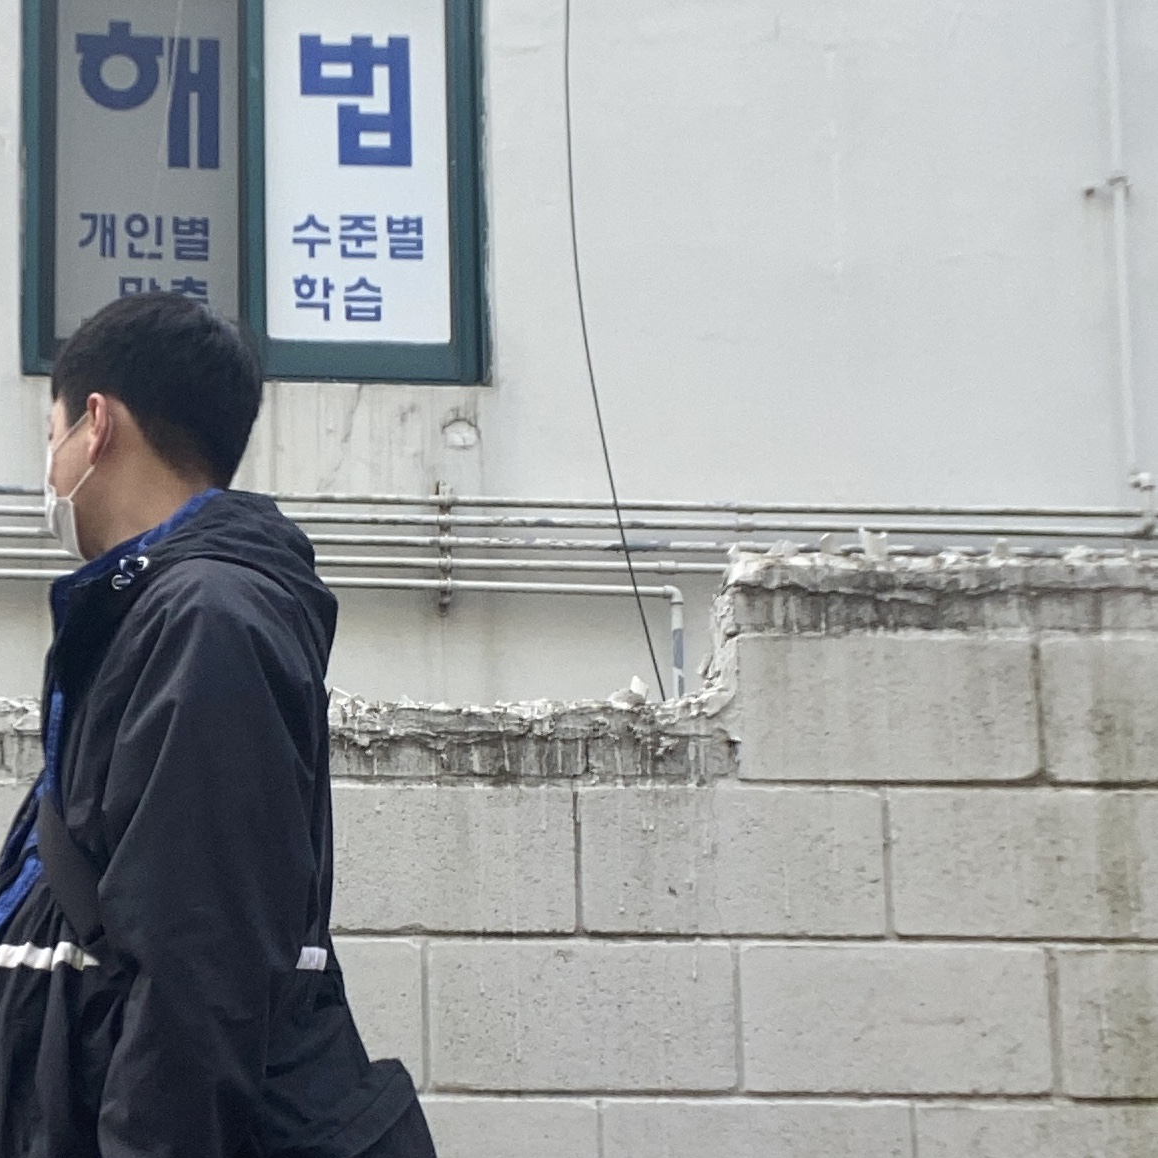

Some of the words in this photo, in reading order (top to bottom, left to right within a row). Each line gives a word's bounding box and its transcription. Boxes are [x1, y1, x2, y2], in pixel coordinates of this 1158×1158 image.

[75, 20, 220, 169] 해
[299, 34, 412, 167] 법
[78, 213, 210, 261] 개인별
[292, 214, 424, 260] 수준별
[293, 274, 383, 322] 학습
